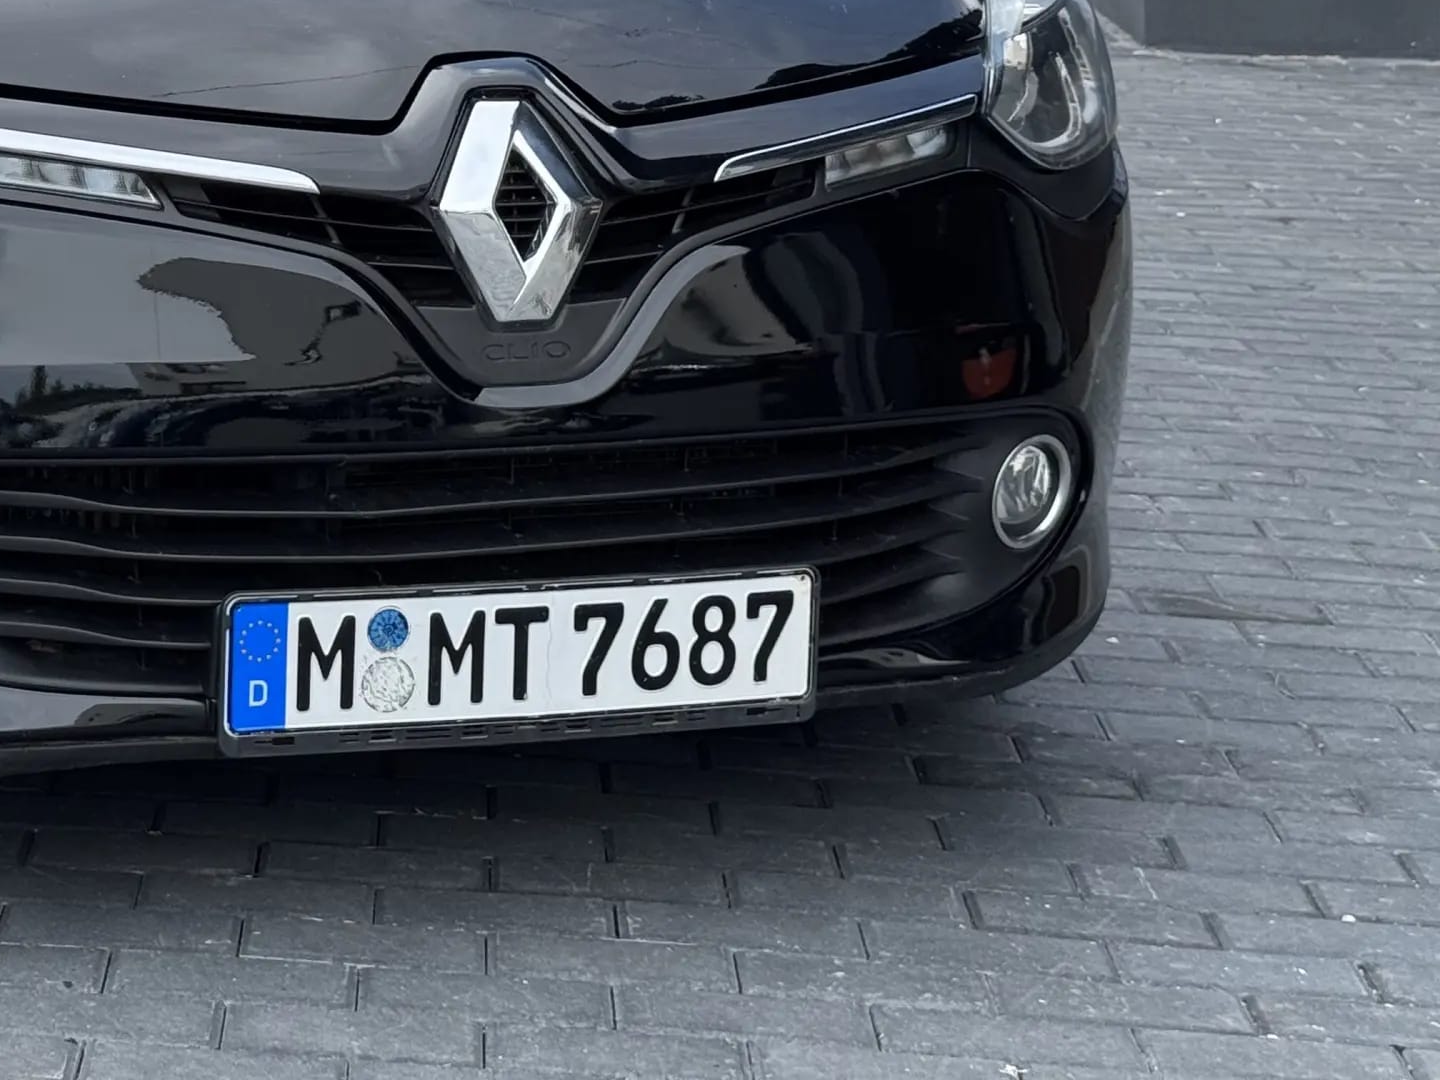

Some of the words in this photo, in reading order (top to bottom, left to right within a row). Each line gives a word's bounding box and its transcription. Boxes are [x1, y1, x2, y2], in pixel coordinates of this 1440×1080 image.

[481, 340, 571, 360] CLIO
[296, 615, 356, 712] M
[427, 605, 549, 705] MT
[574, 589, 795, 696] 7687
[248, 680, 268, 707] D
